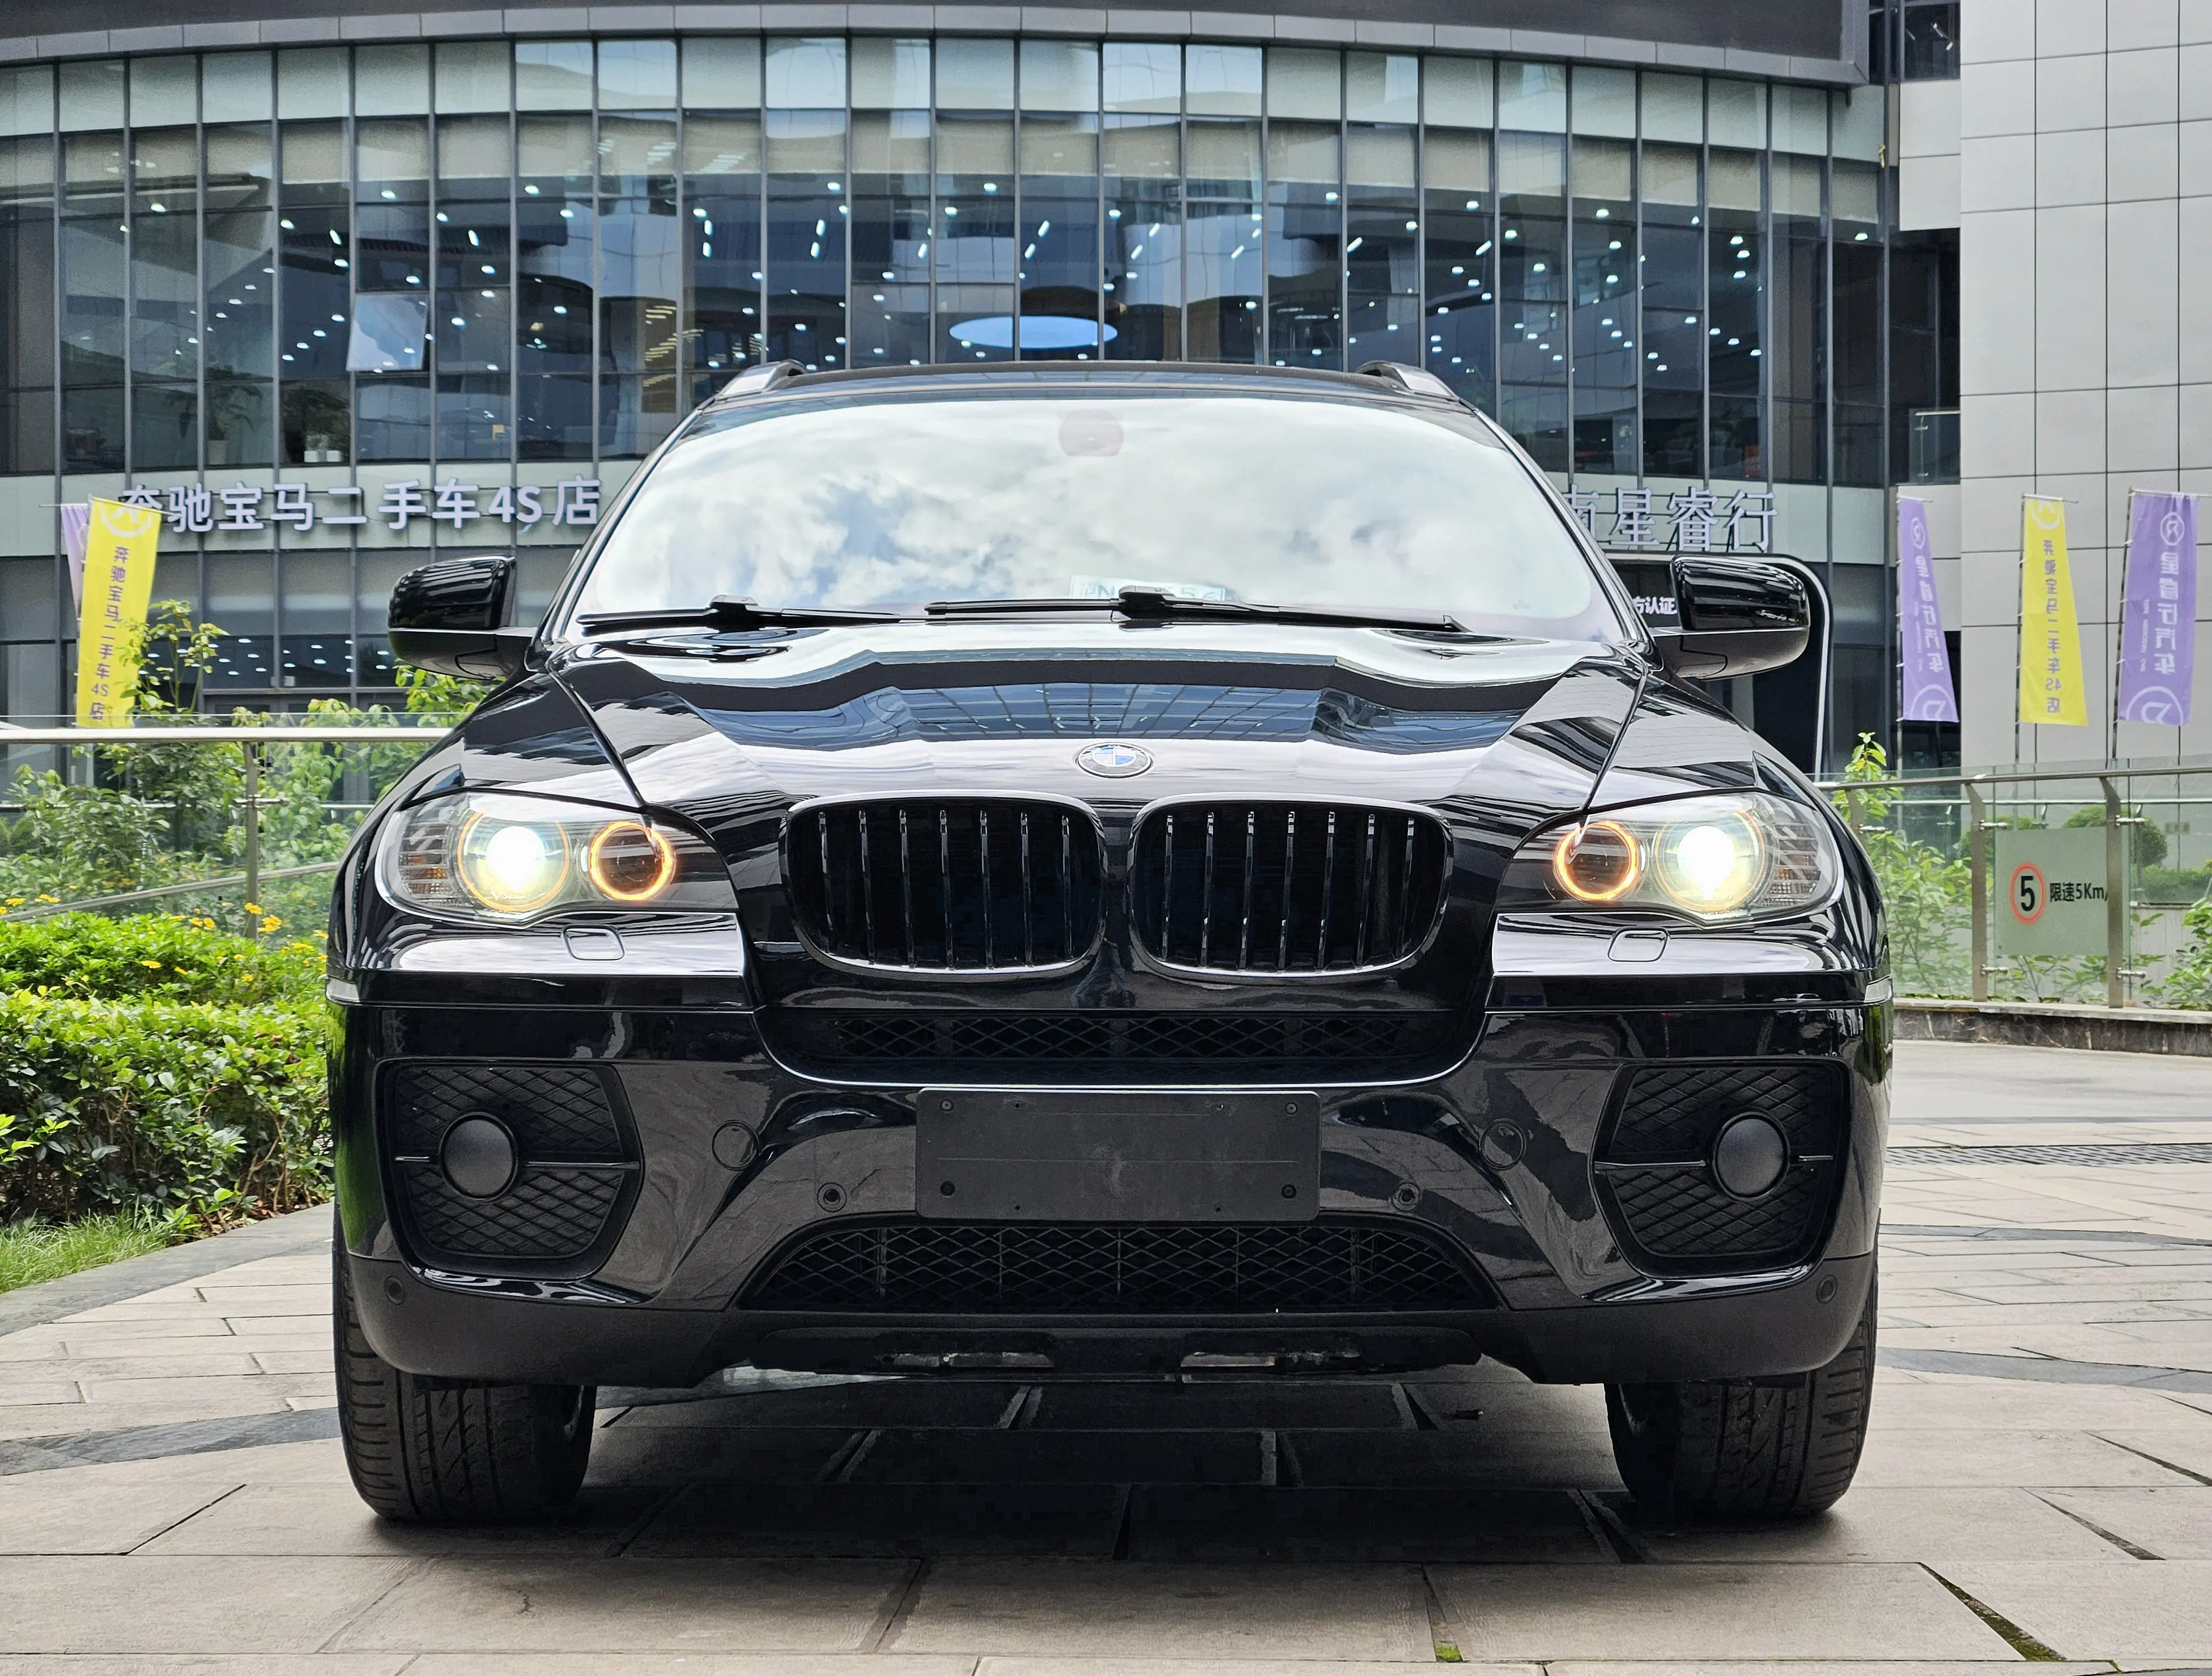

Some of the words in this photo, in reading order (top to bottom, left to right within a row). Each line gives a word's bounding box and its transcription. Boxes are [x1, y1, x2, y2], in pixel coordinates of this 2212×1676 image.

[122, 475, 600, 533] 奔驰宝马二手车4S店
[2020, 875, 2035, 912] 5
